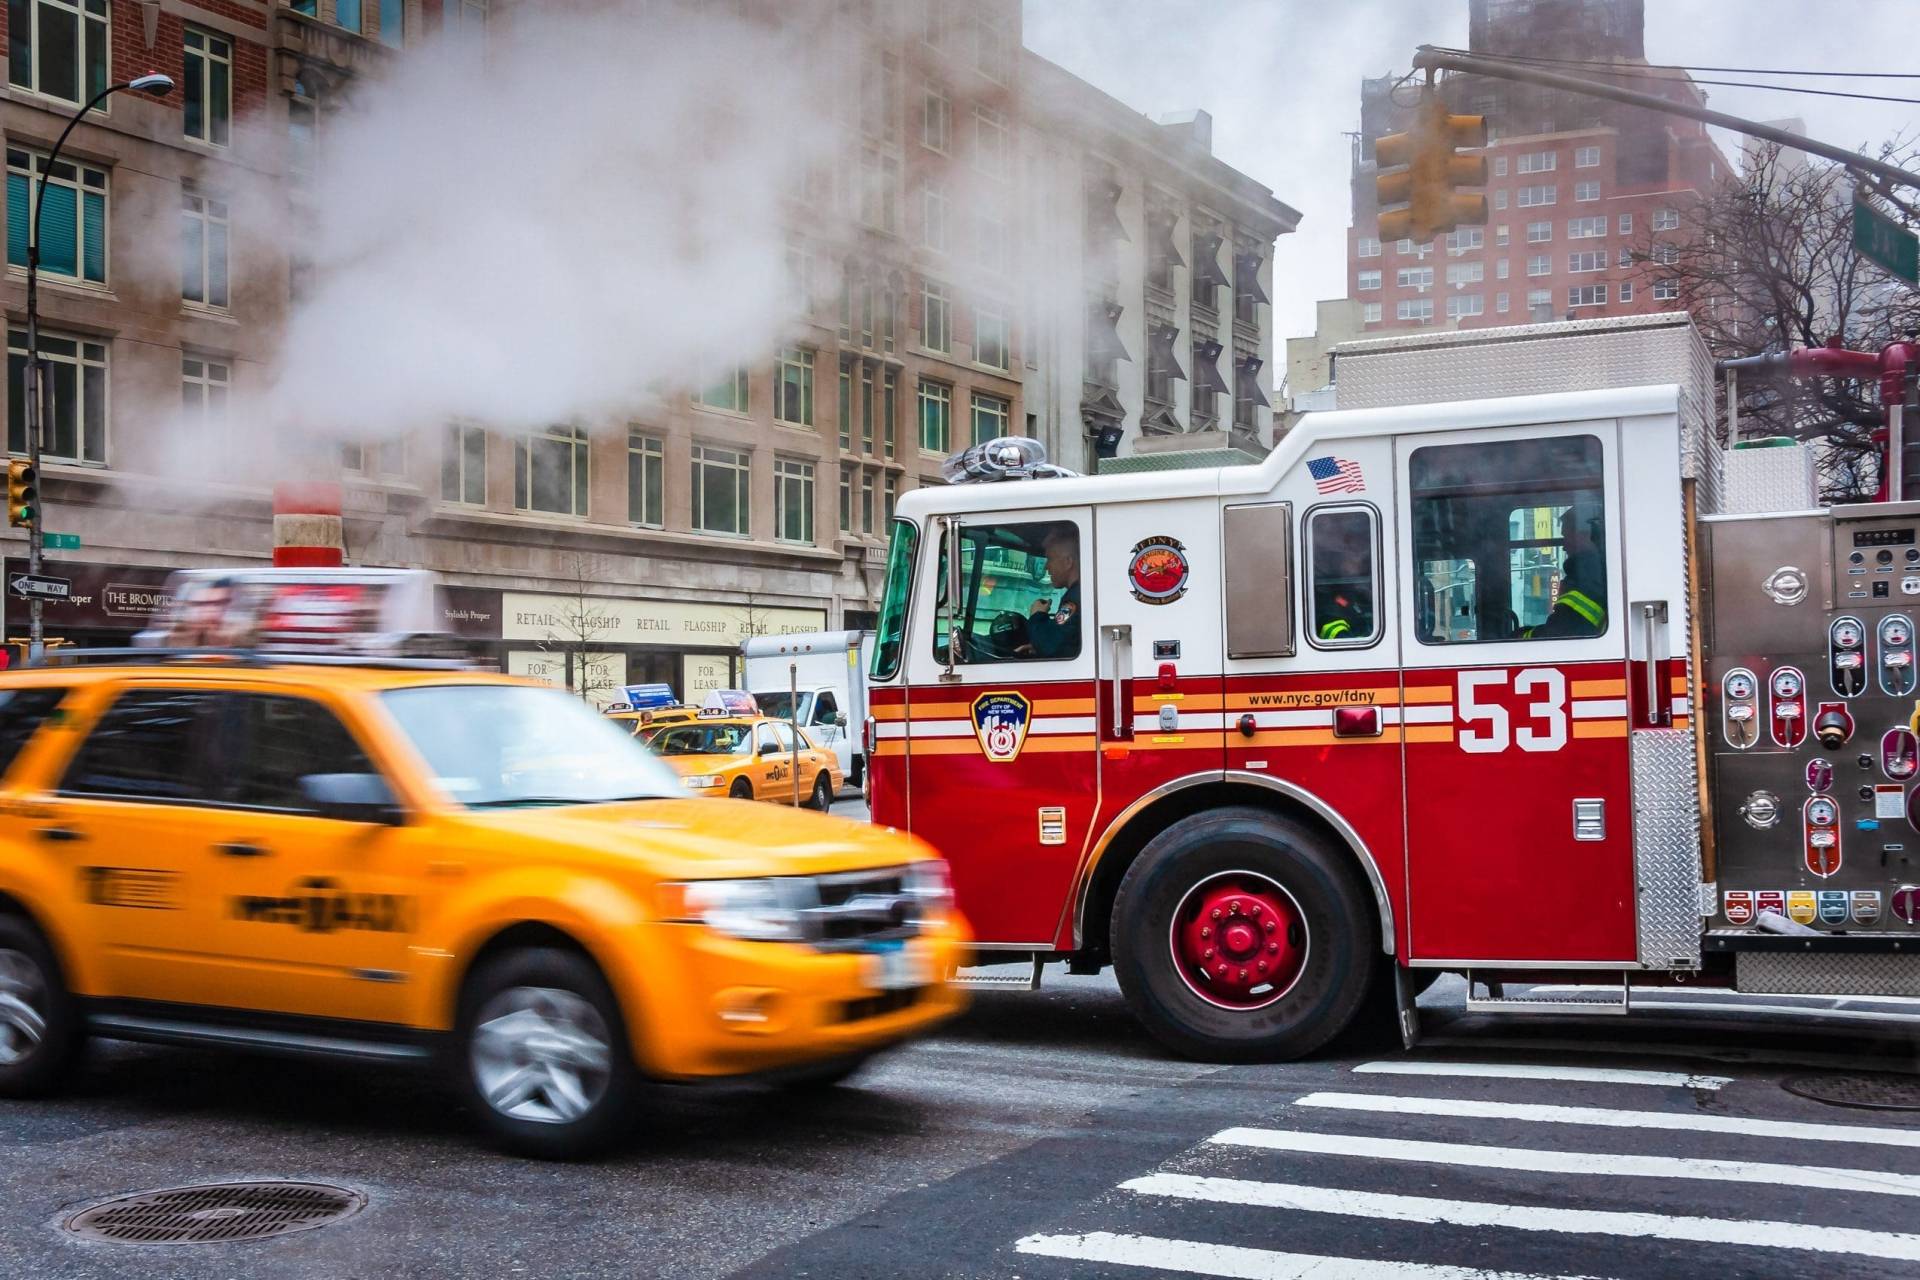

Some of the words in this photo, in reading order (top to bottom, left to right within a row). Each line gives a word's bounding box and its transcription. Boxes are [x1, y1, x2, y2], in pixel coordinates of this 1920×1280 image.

[1140, 537, 1177, 548] FDNY
[18, 581, 36, 590] ONE
[47, 584, 64, 593] WAY
[70, 596, 92, 606] oper
[108, 592, 127, 604] THE
[470, 610, 491, 622] Proper
[516, 612, 555, 626] RETAIL
[570, 615, 621, 629] FLAGSHIP
[637, 618, 670, 631] RETAIL
[684, 620, 727, 633] FLAGSHIP
[740, 623, 768, 634] RETAIL
[781, 624, 818, 634] FLAGSHIP
[527, 663, 548, 675] FOR
[590, 664, 609, 676] FOR
[698, 666, 714, 677] FOR
[585, 679, 614, 690] LEASE
[694, 680, 719, 690] LEASE
[1249, 690, 1375, 706] www.nyc.gov/fdny
[1457, 667, 1567, 753] 53
